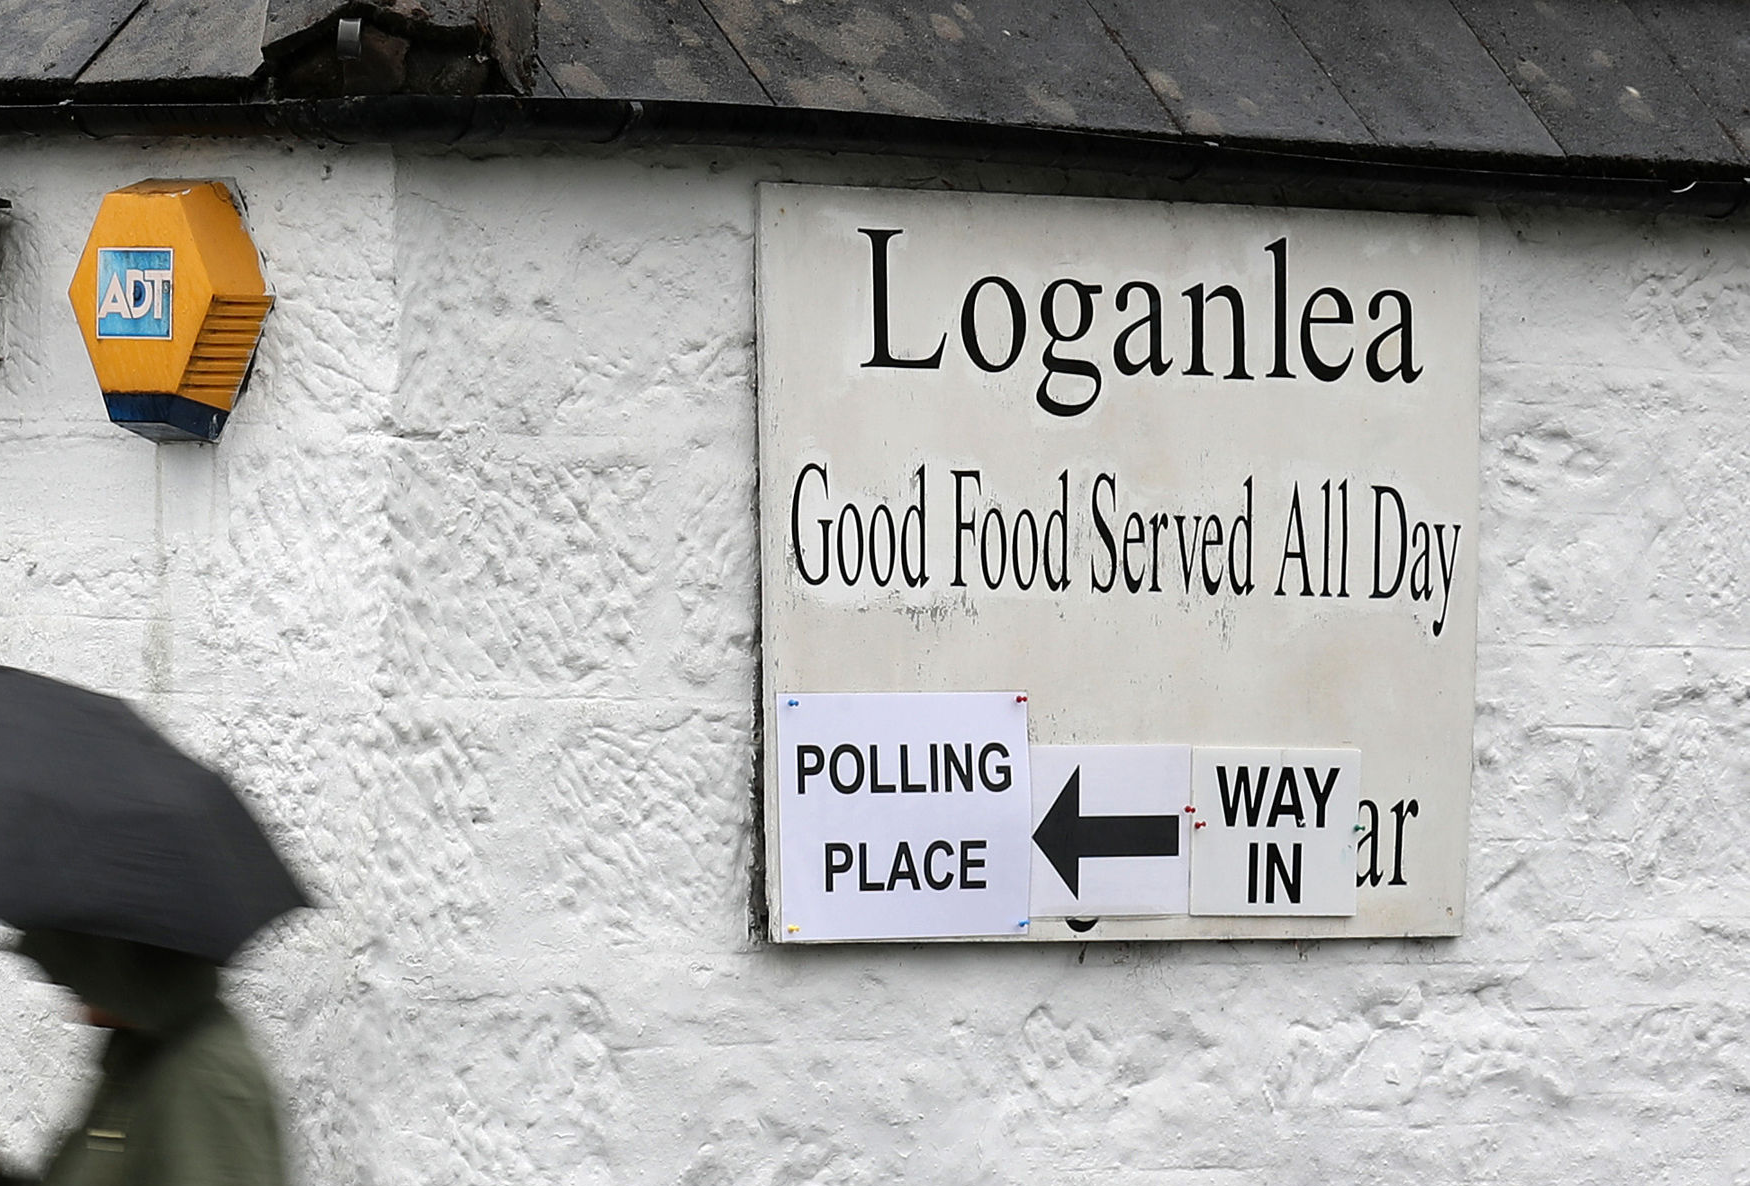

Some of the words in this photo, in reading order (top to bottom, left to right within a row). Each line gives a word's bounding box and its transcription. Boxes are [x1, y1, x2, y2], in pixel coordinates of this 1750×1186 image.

[98, 268, 171, 320] ADT
[856, 226, 1424, 417] Loganlea
[791, 462, 930, 588] Good
[950, 469, 1072, 592] Food
[1090, 472, 1255, 596] Served
[1274, 478, 1351, 598] All
[1368, 485, 1462, 638] Day
[796, 741, 1013, 795] POLLING
[1216, 765, 1341, 828] WAY
[824, 839, 988, 893] PLACE
[1247, 842, 1303, 905] IN
